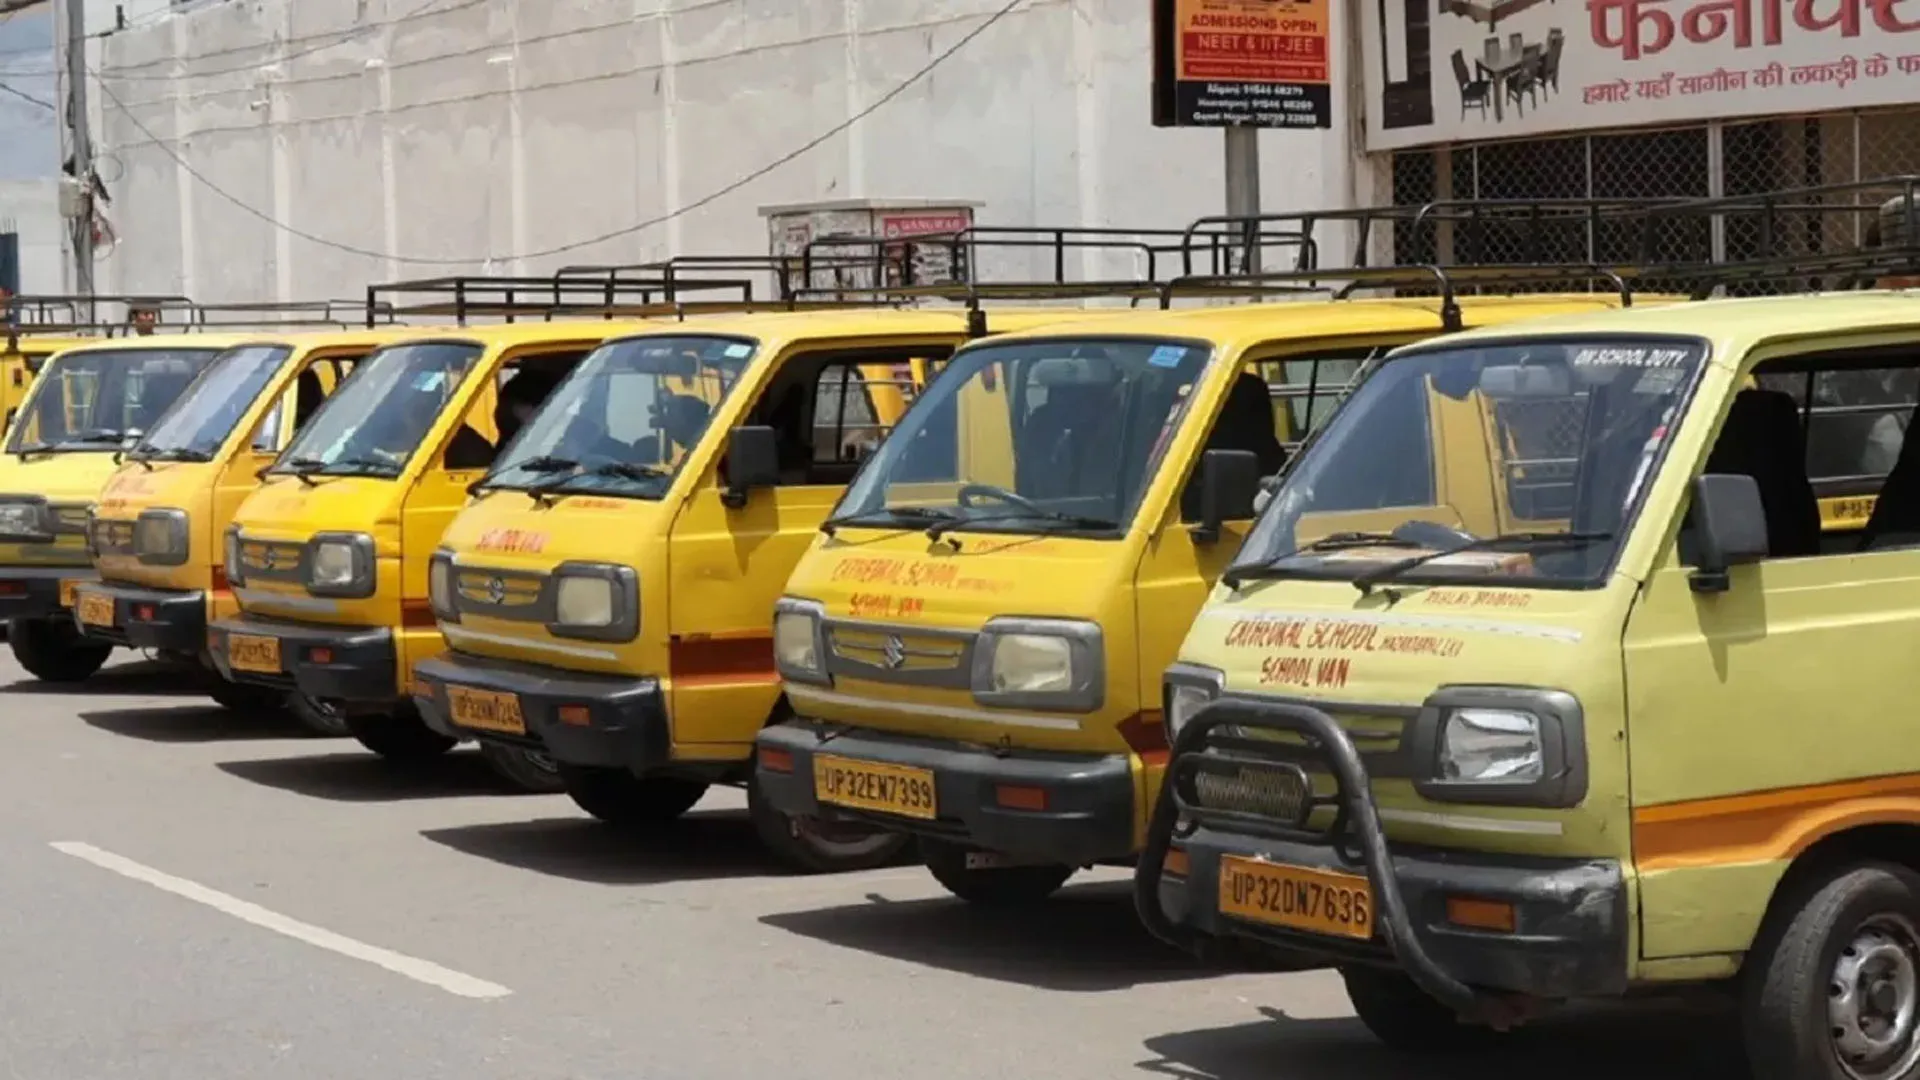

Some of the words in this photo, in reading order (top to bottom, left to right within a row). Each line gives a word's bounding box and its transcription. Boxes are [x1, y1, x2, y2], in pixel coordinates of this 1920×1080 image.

[1191, 14, 1277, 29] ADMISSIONS
[1280, 18, 1317, 32] OPEN
[1198, 35, 1239, 50] NEET
[1246, 37, 1256, 50] &
[1261, 37, 1313, 52] IIT-JEE
[1583, 79, 1630, 104] हमारे
[1752, 62, 1784, 88] की
[1864, 53, 1890, 78] के
[1593, 349, 1646, 366] SCHOOL
[1645, 349, 1688, 366] DUTY
[903, 561, 960, 589] SCHOOL
[849, 592, 892, 617] SCHOOL
[897, 597, 926, 618] VAN
[1225, 619, 1308, 649] CATHEDRAL
[1306, 621, 1378, 651] SCHOOL
[1260, 656, 1312, 687] SCHOOL
[1316, 658, 1351, 688] VAN
[825, 767, 932, 809] UP32EN7399
[1232, 870, 1368, 926] UP32DN7636
